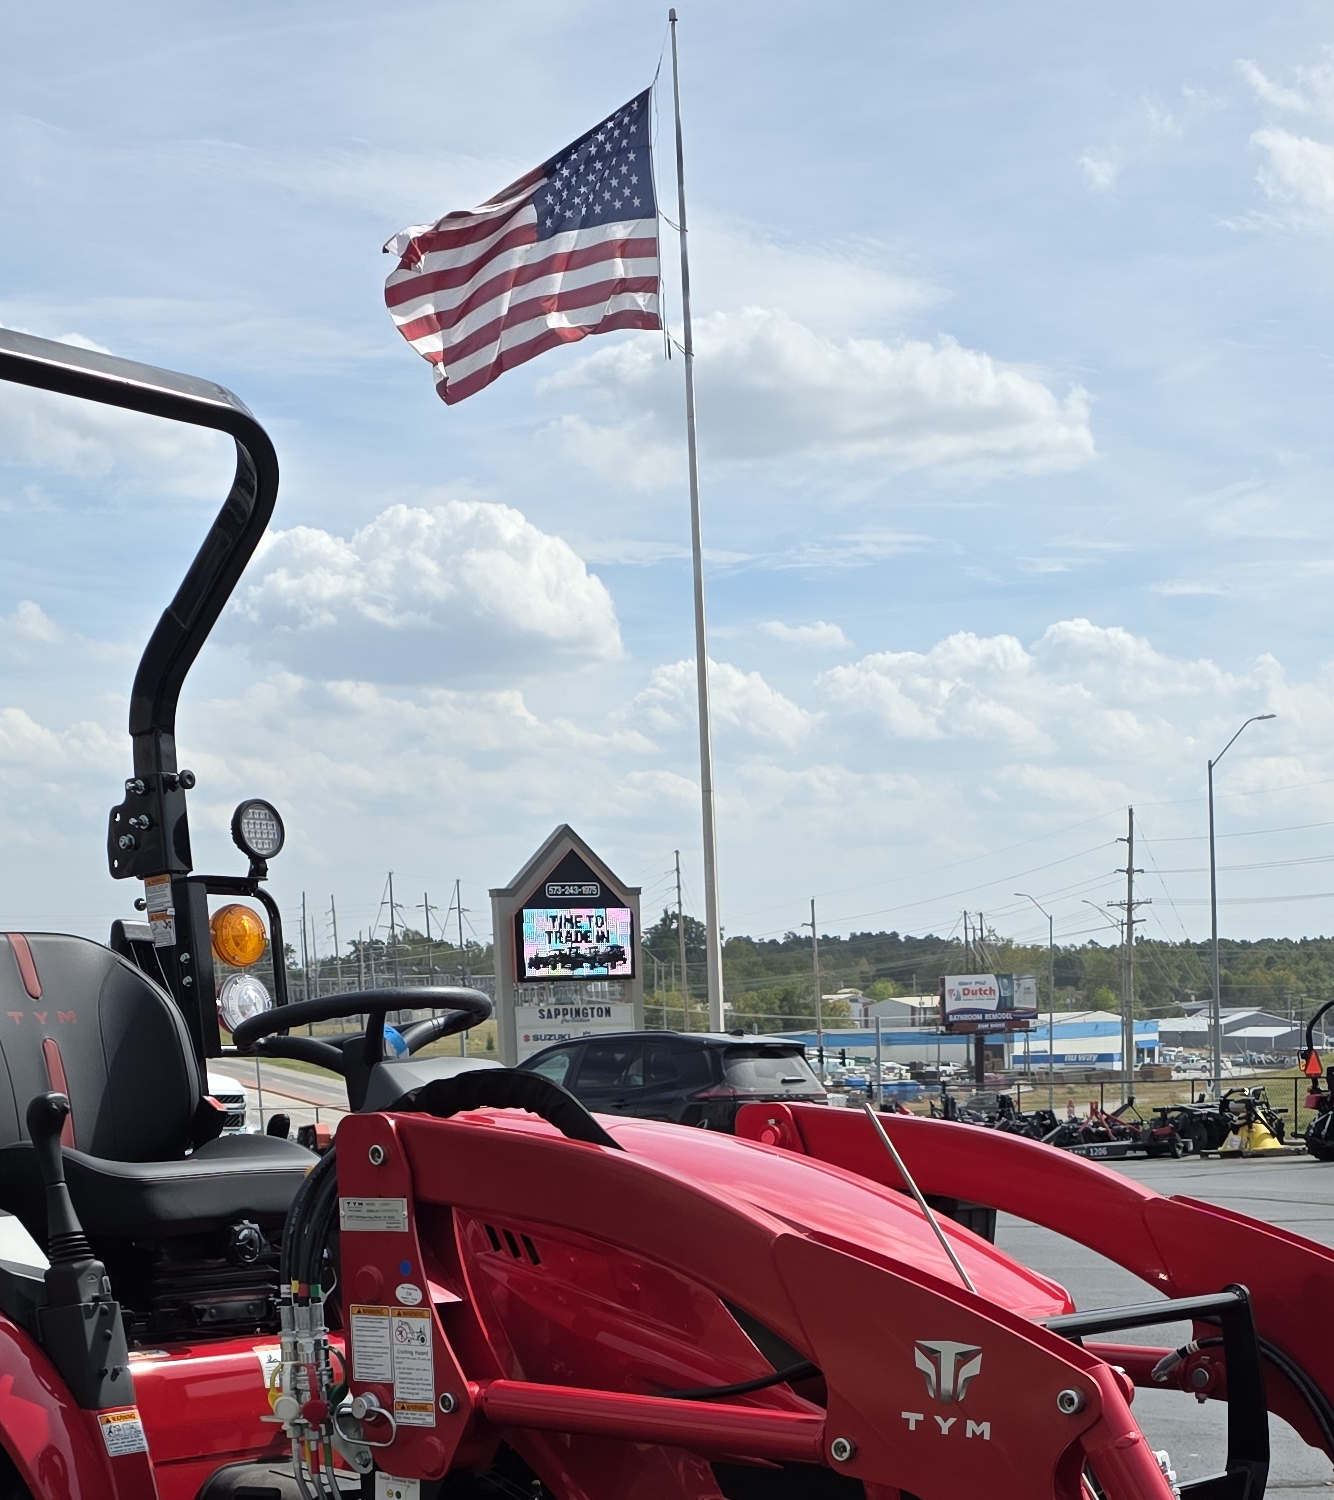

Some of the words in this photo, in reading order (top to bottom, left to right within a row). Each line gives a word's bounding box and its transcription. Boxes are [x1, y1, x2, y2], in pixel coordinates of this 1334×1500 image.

[548, 885, 598, 895] 573-243-1975
[587, 914, 605, 928] TO
[545, 930, 593, 944] TRADE
[595, 929, 611, 943] IN
[962, 986, 996, 997] Dutch
[7, 1010, 79, 1025] TYM
[538, 1006, 612, 1020] SAPPINGTON
[948, 1013, 983, 1022] BATHROOM
[984, 1012, 1013, 1021] REMODEL
[531, 1033, 571, 1042] SUZUKI
[1064, 1054, 1077, 1062] nu
[1078, 1054, 1098, 1062] way
[1089, 1147, 1108, 1156] 1206
[901, 1411, 991, 1441] TYM
